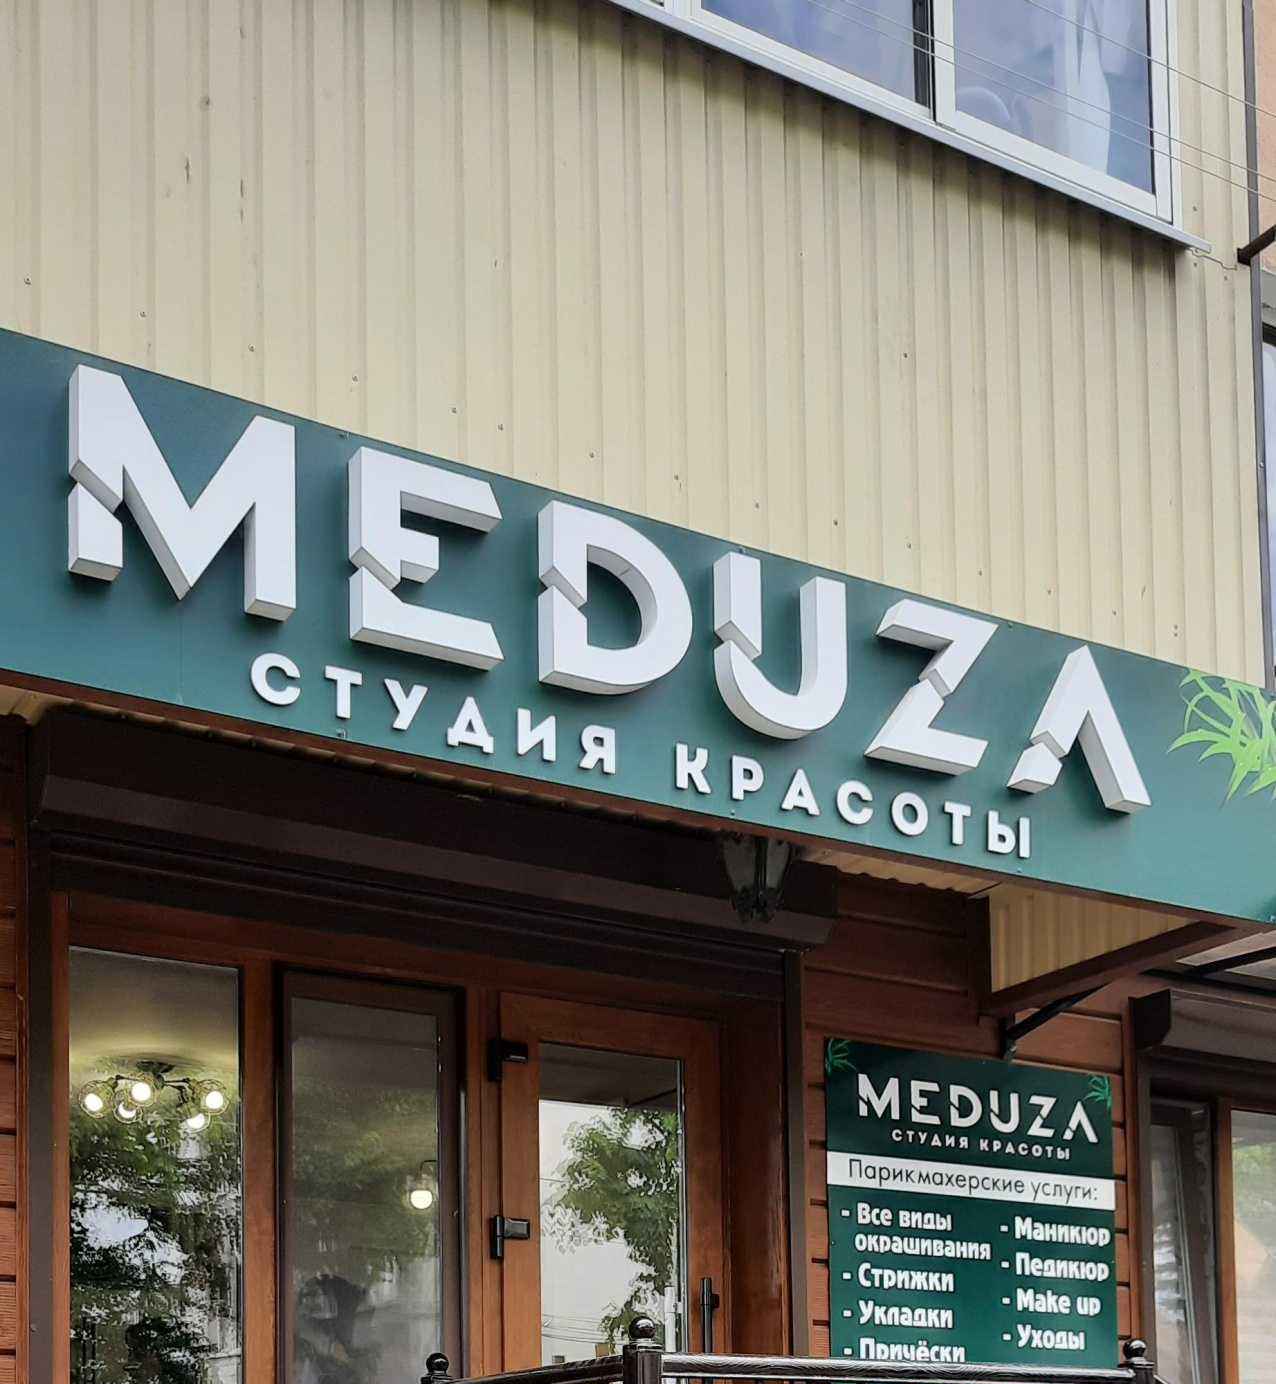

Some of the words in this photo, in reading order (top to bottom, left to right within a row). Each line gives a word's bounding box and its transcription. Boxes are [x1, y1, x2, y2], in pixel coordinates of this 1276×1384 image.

[68, 363, 1152, 814] MEDUZA
[250, 652, 617, 775] СТУДИЯ
[675, 742, 1032, 860] КРАСОТЫ
[858, 1073, 1098, 1142] MEDUZA
[892, 1129, 969, 1149] СТУДИЯ
[980, 1136, 1070, 1160] КРАСОТЫ
[849, 1159, 1025, 1195] Парикмахерские
[1032, 1183, 1098, 1203] услуги:
[857, 1203, 892, 1226] Все
[899, 1208, 952, 1231] виды
[1015, 1217, 1111, 1247] Маникюр
[855, 1234, 991, 1260] окрашивания
[858, 1263, 954, 1292] Стрижки
[1016, 1252, 1109, 1281] Педикюр
[859, 1301, 953, 1328] Укладки
[1017, 1288, 1070, 1314] Make
[1077, 1297, 1101, 1315] up
[860, 1338, 965, 1362] Причёски
[1018, 1325, 1085, 1350] Уходы
